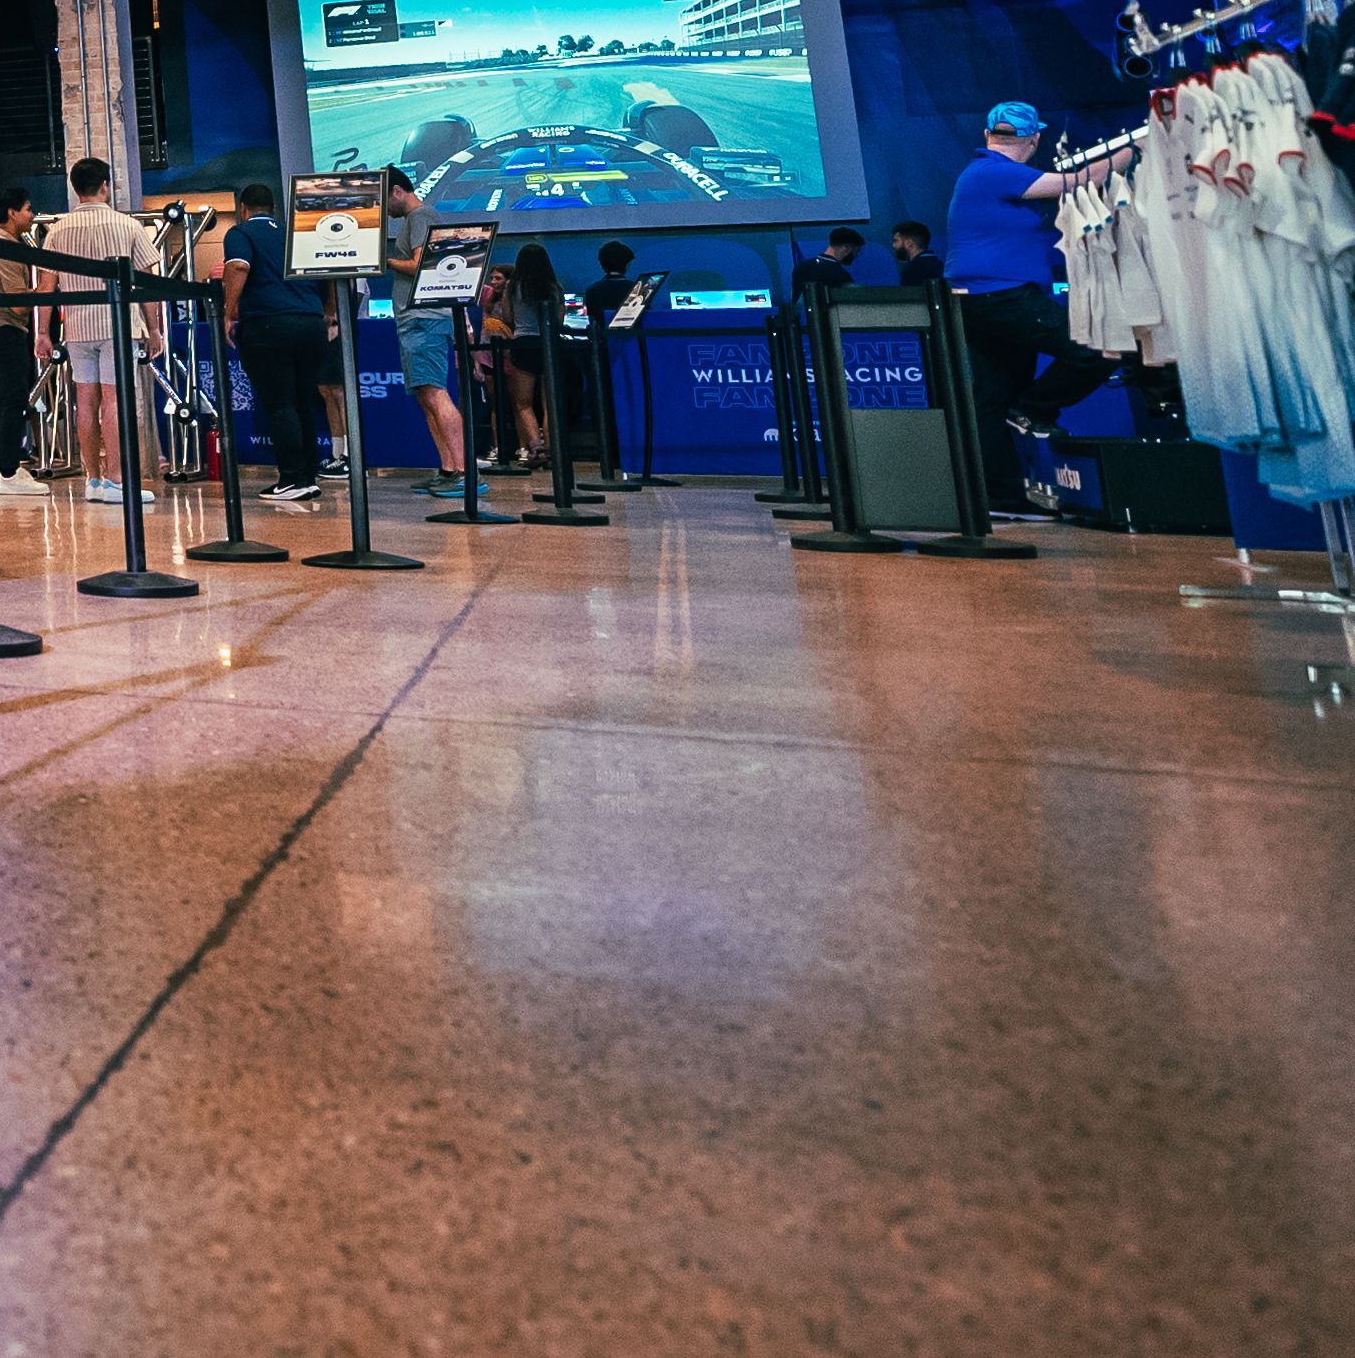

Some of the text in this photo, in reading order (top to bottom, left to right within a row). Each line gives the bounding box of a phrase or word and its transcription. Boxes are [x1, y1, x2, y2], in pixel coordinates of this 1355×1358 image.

[663, 152, 729, 202] DURACELL
[315, 250, 358, 259] FW46
[420, 284, 473, 293] KOMATSU
[359, 372, 405, 385] OUR
[843, 366, 923, 383] ACING
